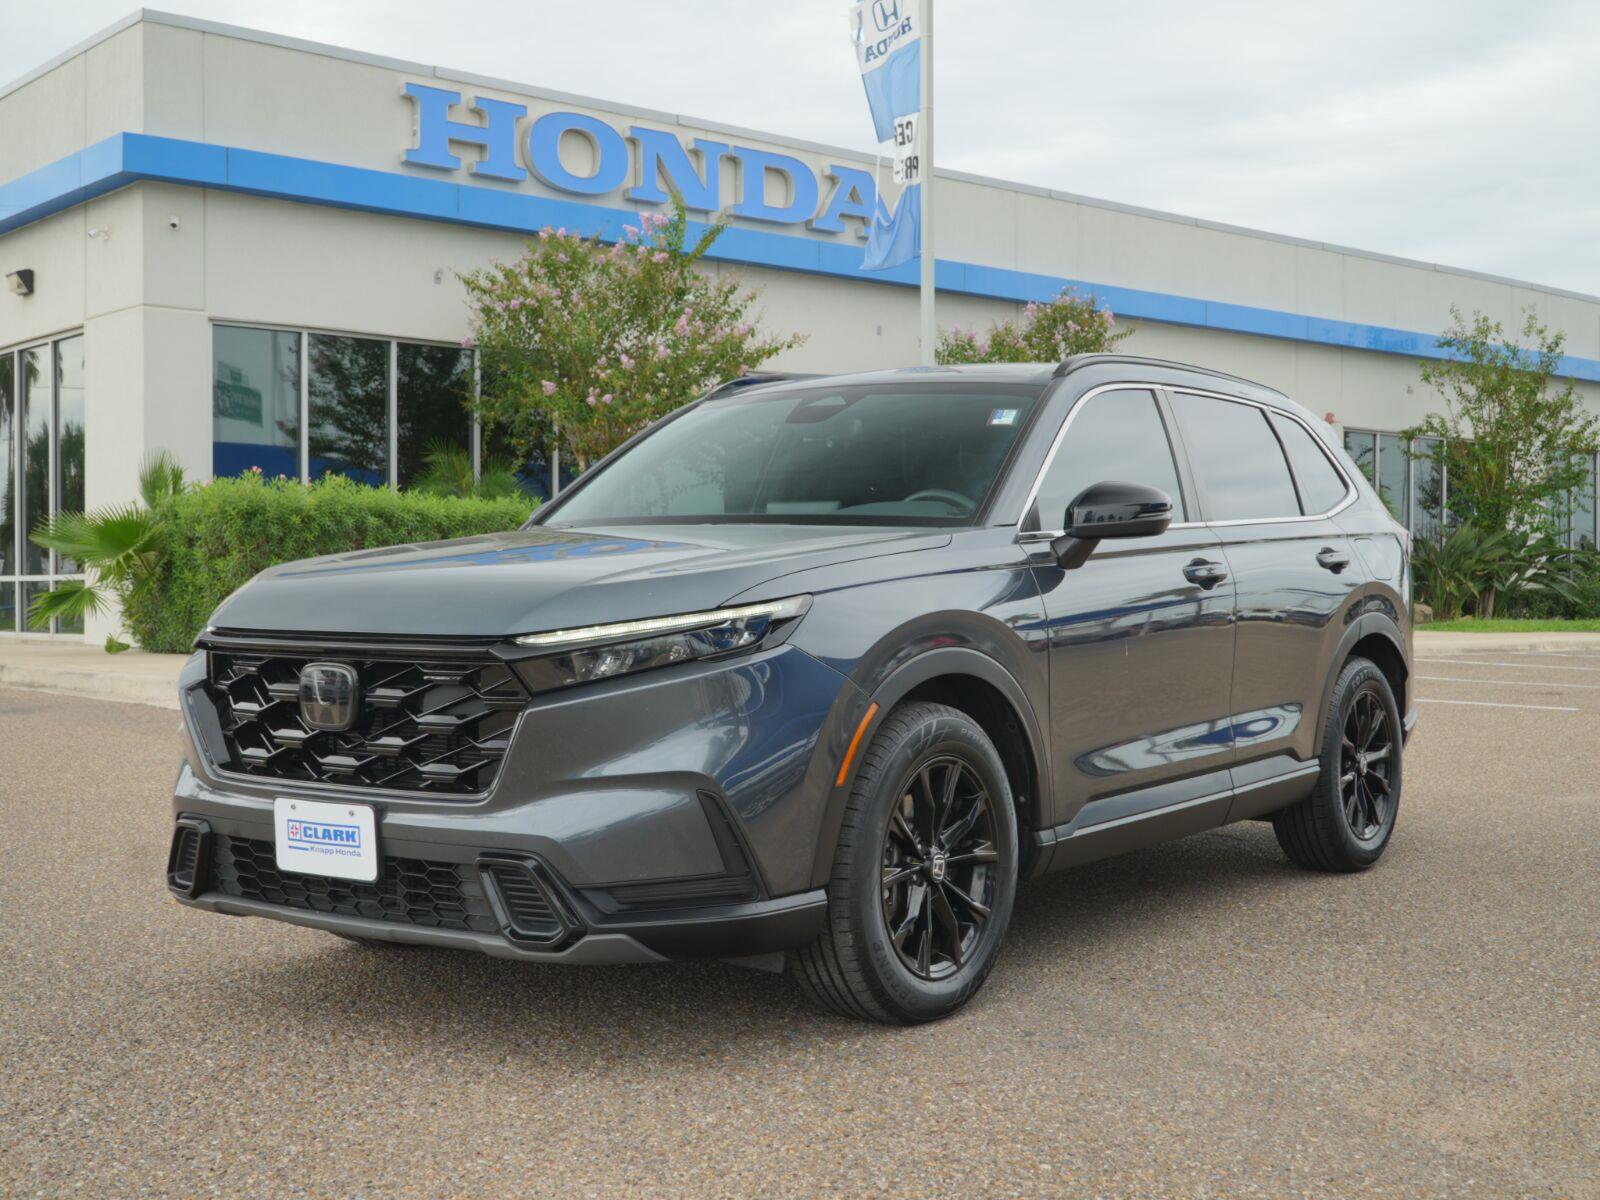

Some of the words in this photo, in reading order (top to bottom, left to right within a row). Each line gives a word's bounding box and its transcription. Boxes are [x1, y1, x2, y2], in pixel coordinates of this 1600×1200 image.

[402, 82, 891, 237] HONDA
[303, 826, 356, 842] CLARK
[310, 846, 334, 855] Knapp
[335, 848, 361, 857] Honda
